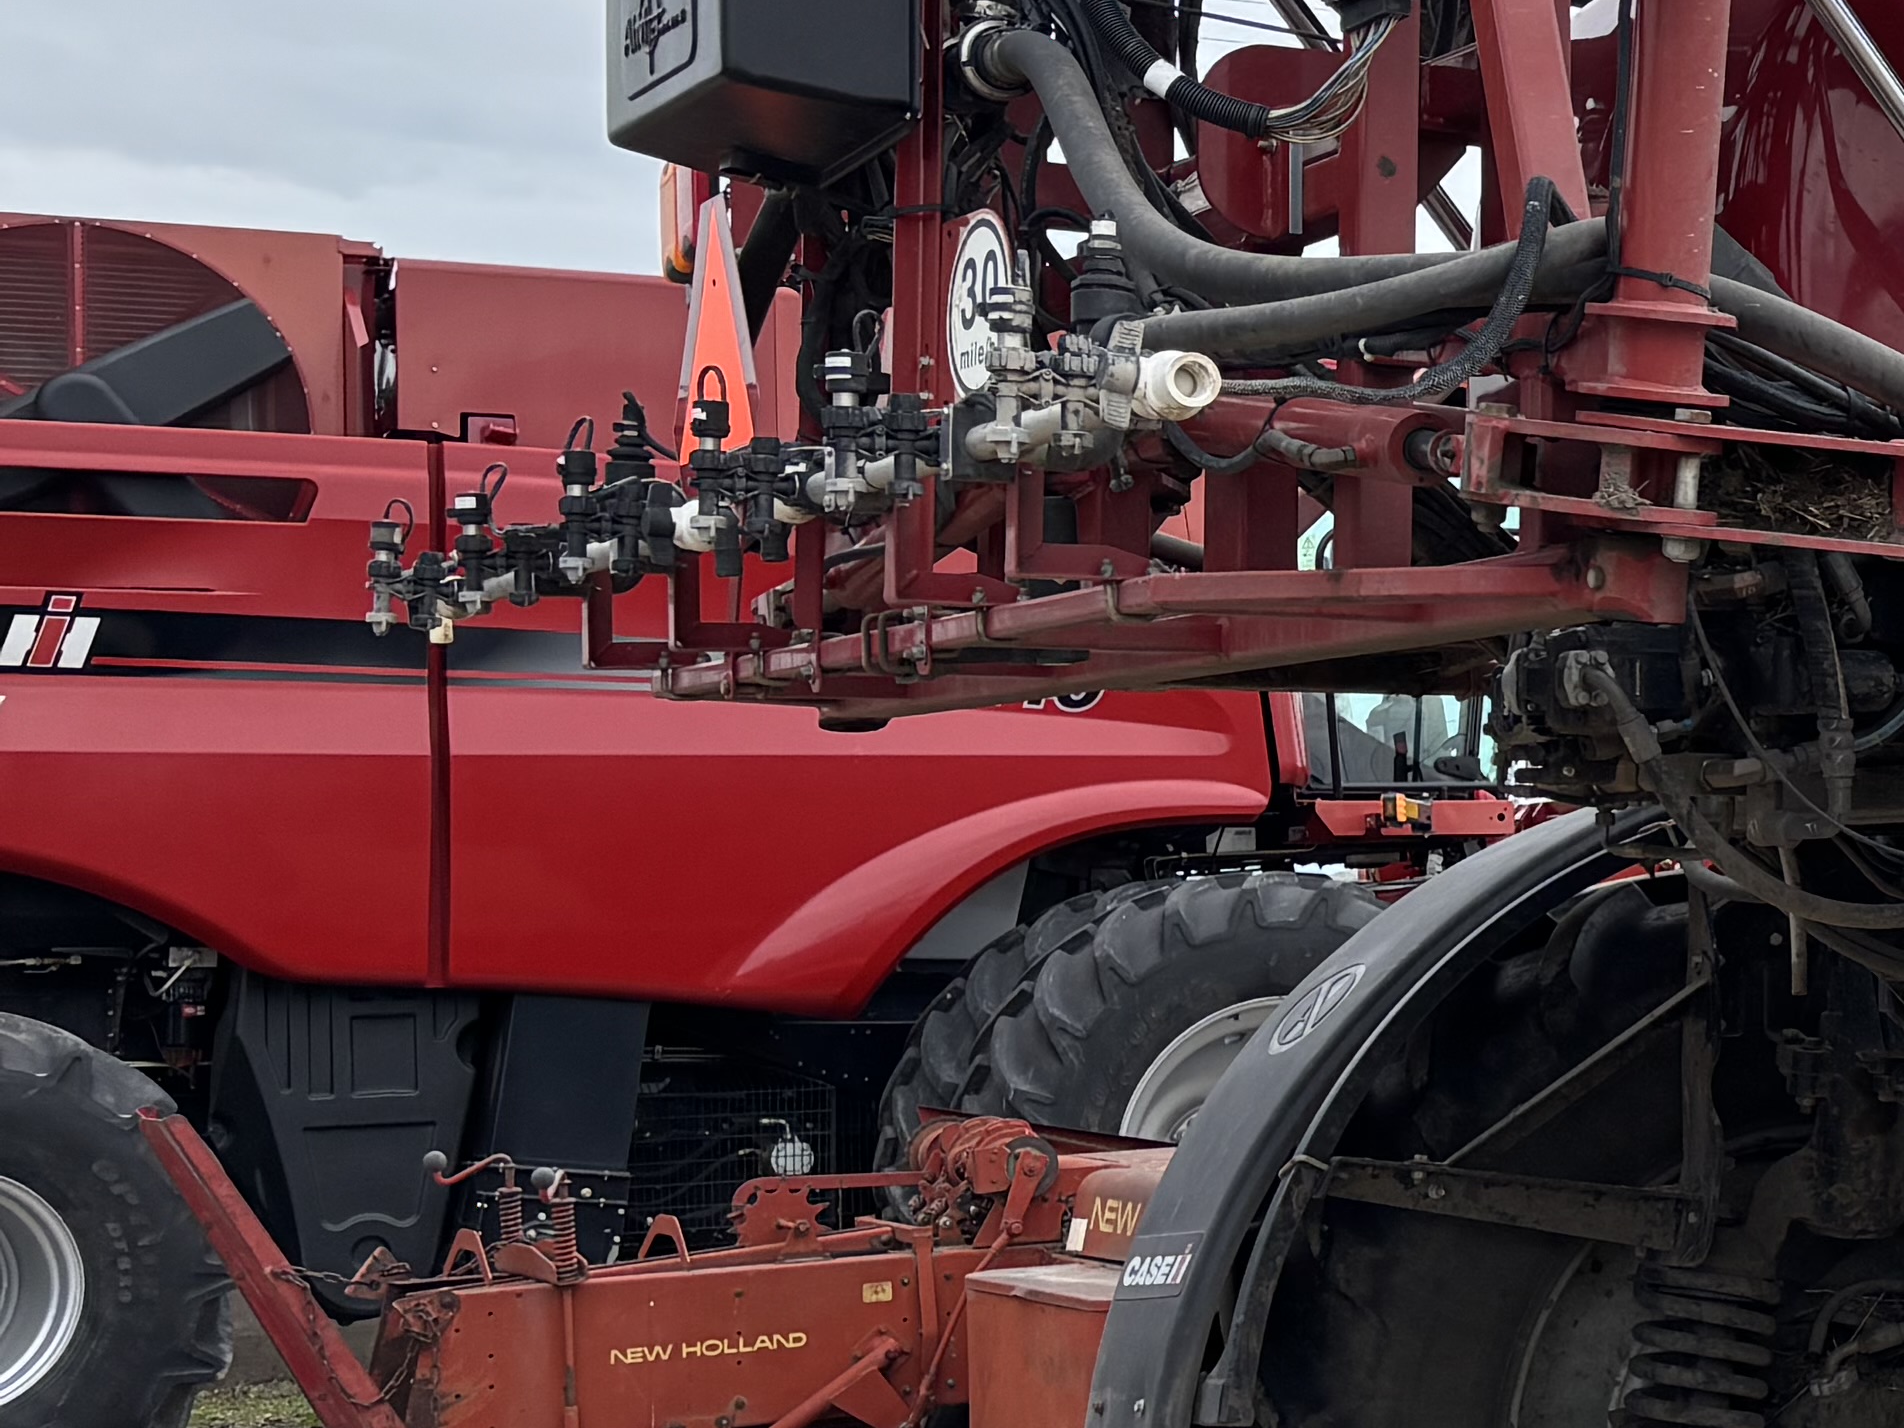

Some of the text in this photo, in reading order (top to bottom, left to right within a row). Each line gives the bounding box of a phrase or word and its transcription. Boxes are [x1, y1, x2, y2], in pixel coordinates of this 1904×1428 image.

[961, 249, 998, 330] 30
[1089, 1196, 1142, 1237] NEW
[610, 1332, 807, 1365] NEW HOLLAND
